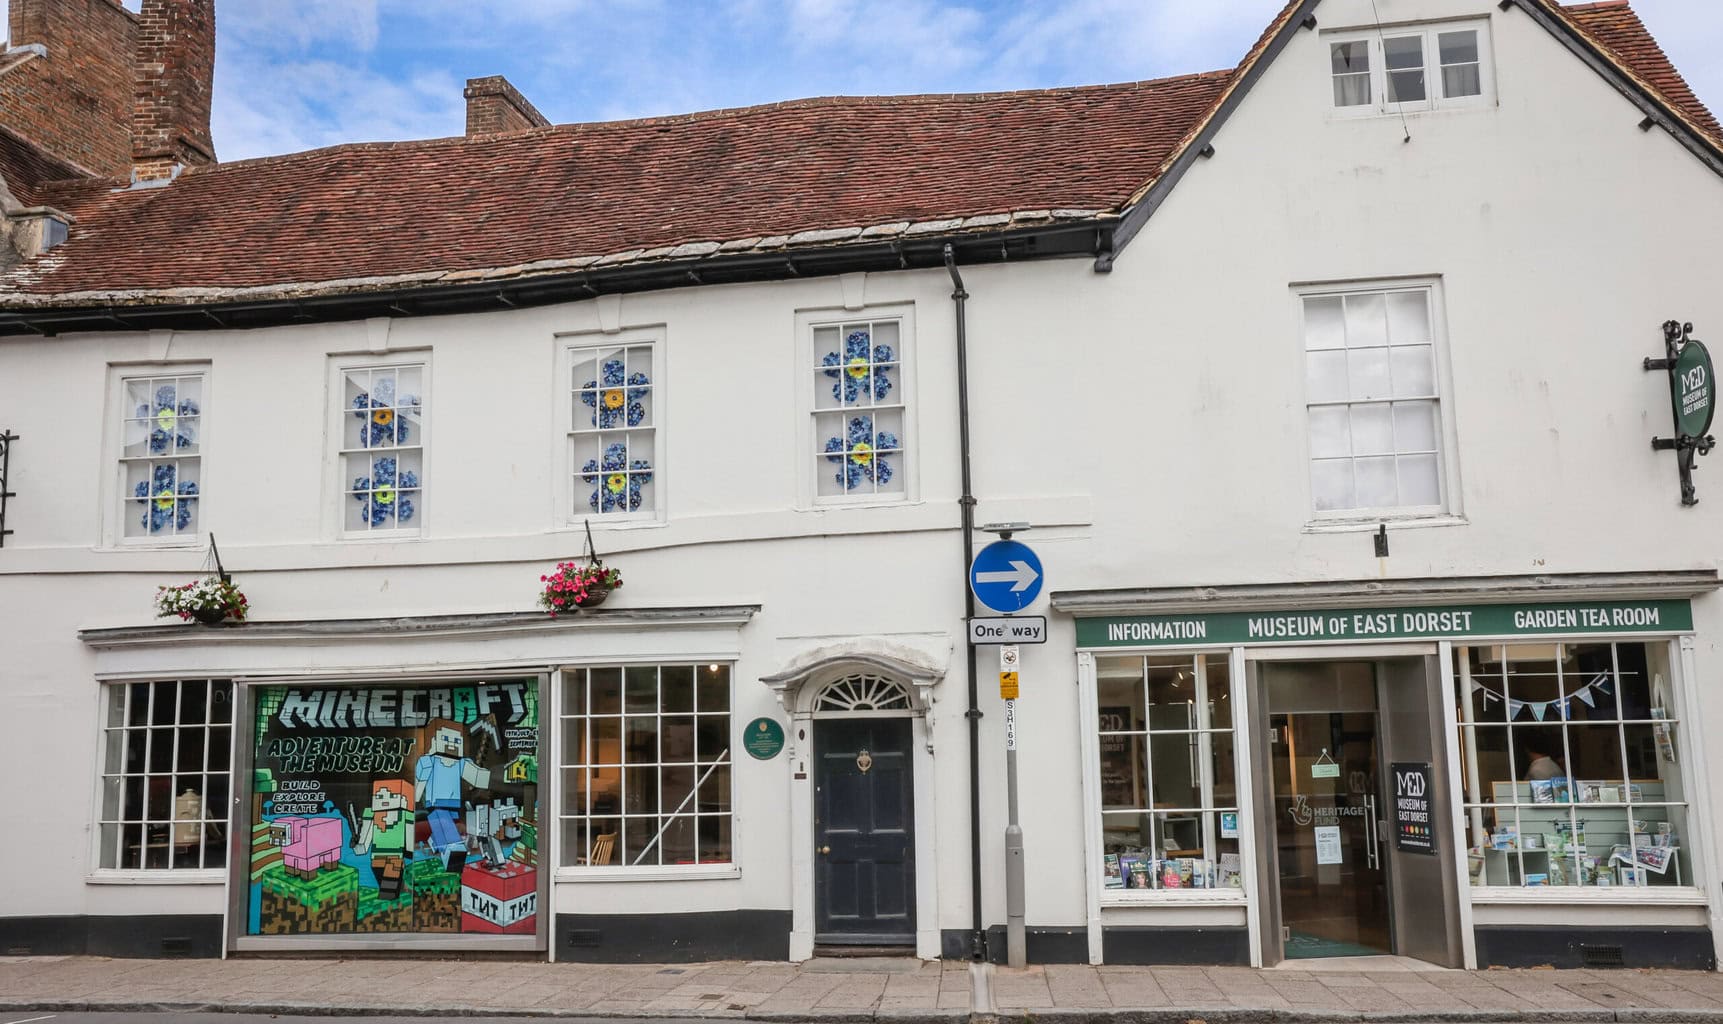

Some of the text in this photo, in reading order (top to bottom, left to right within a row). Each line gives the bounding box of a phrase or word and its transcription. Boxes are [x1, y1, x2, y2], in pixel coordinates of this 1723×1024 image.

[1681, 365, 1705, 395] MED
[1683, 389, 1701, 406] MUSEUM
[1248, 611, 1472, 638] MUSEUM OF EAST DORSET
[1514, 607, 1660, 628] GARDEN TEA ROOM
[975, 625, 1041, 638] One way
[1108, 621, 1206, 641] INFORMATION
[278, 684, 530, 728] MINECRAFT
[267, 736, 416, 757] ADVENTURE AT
[279, 753, 404, 773] THE MUSEUM
[281, 780, 320, 791] BUILD
[1397, 772, 1425, 797] MED
[273, 791, 326, 802] EXPLORE
[1397, 798, 1427, 811] MUSEUM OF
[273, 803, 318, 814] CREATE
[1314, 807, 1365, 816] HERITAGE
[1398, 810, 1428, 822] EAST DORSET
[1314, 817, 1340, 826] FUND
